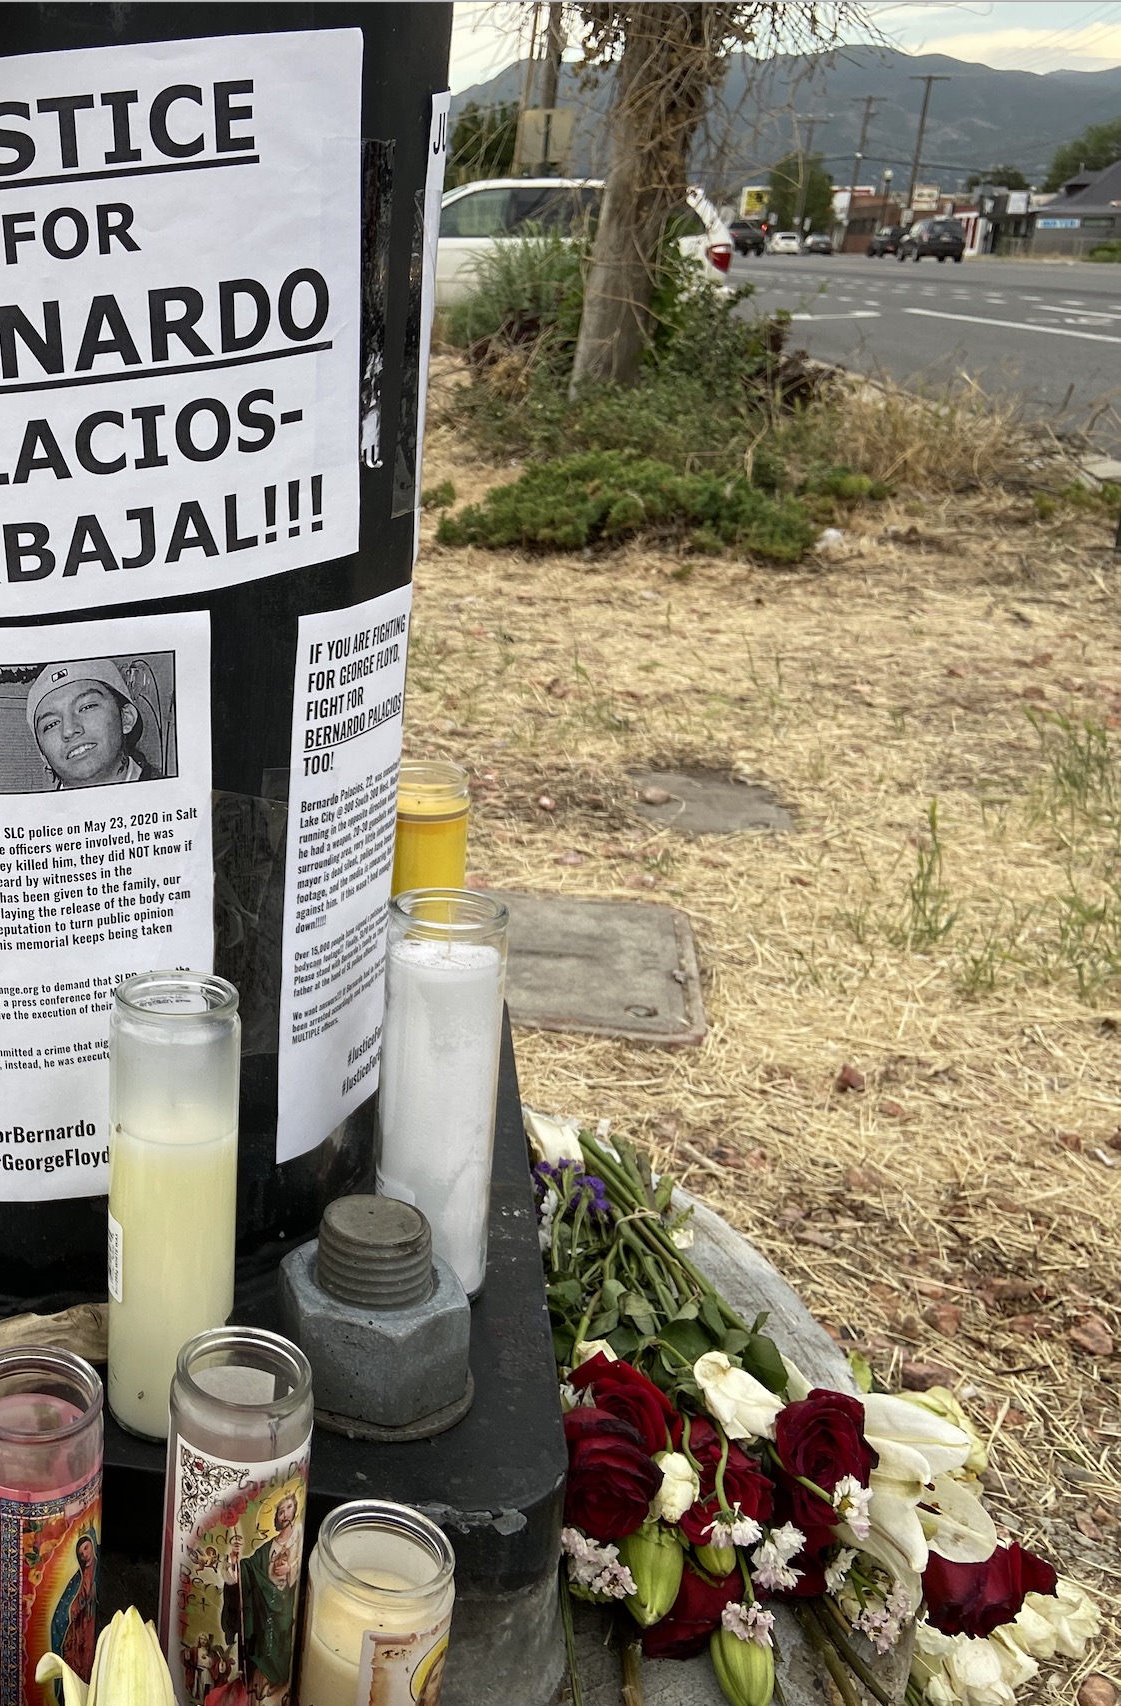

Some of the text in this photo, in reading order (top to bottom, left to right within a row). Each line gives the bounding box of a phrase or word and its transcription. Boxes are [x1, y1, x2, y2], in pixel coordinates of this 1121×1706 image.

[2, 202, 141, 265] FOR
[309, 613, 406, 665] IF YOU ARE FIGHTING
[307, 643, 400, 693] FOR GEORGE FLOYD,
[306, 686, 364, 722] FIGHT FOR
[304, 692, 402, 750] BERNARDO PALACIOS
[303, 752, 334, 776] TOO!
[300, 800, 354, 829] Lake City 900
[301, 793, 339, 813] Bernardo
[3, 826, 25, 839] SLC
[28, 825, 63, 841] police
[66, 825, 81, 835] on
[84, 820, 106, 833] May
[109, 816, 127, 829] 23,
[130, 812, 158, 827] 2020
[162, 811, 173, 823] in
[176, 807, 197, 821] Salt
[299, 829, 329, 844] running
[9, 843, 52, 855] officers
[55, 841, 82, 852] were
[85, 831, 134, 849] involved,
[137, 830, 150, 842] he
[153, 829, 174, 840] was
[15, 857, 49, 871] killed
[52, 856, 77, 869] him,
[79, 853, 105, 866] they
[108, 848, 125, 862] did
[128, 845, 150, 859] NOT
[152, 844, 181, 856] know
[184, 839, 192, 852] if
[298, 842, 331, 859] he had a
[298, 853, 340, 875] surrounding
[41, 984, 51, 993] to
[54, 978, 90, 992] demand
[92, 976, 112, 987] that
[291, 1027, 320, 1045] MULTIPLE
